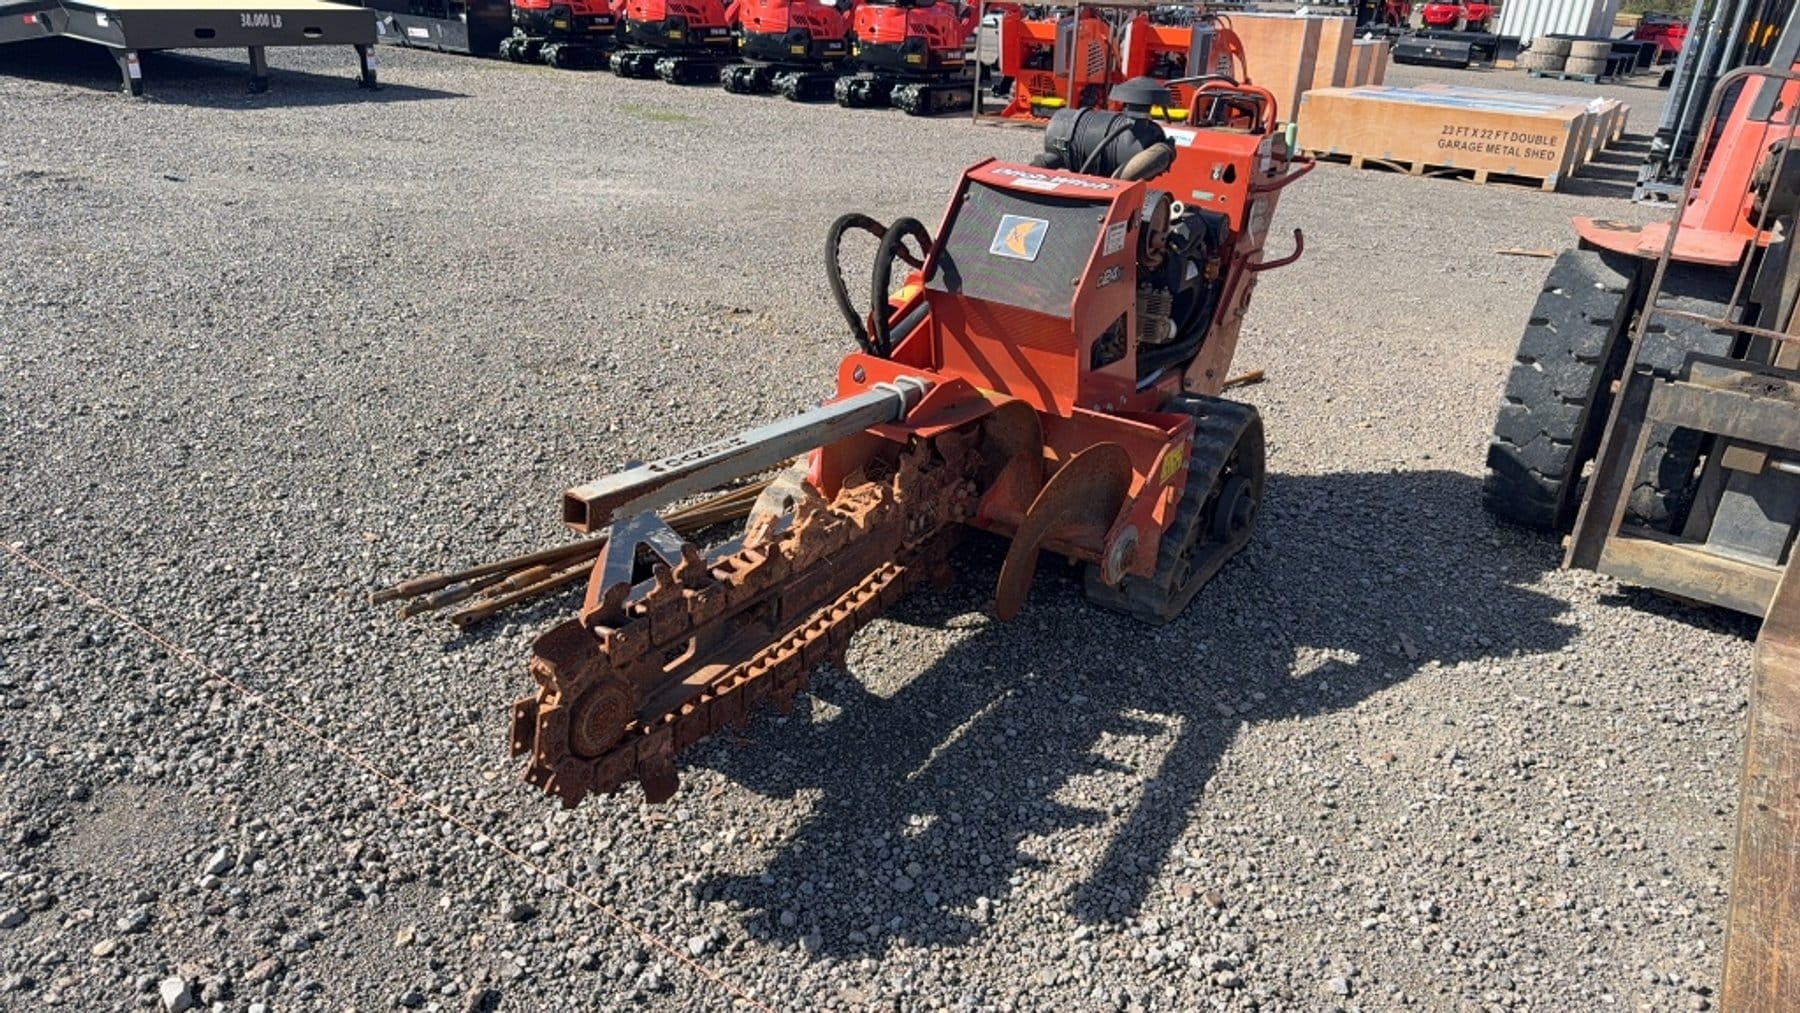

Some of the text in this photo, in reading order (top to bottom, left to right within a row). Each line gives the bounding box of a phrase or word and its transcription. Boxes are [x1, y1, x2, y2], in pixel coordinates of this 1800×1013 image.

[270, 13, 283, 28] LB
[1441, 125, 1558, 147] 23 FT X 22 FT DOUBLE
[1438, 138, 1556, 161] GARAGE METAL SHED
